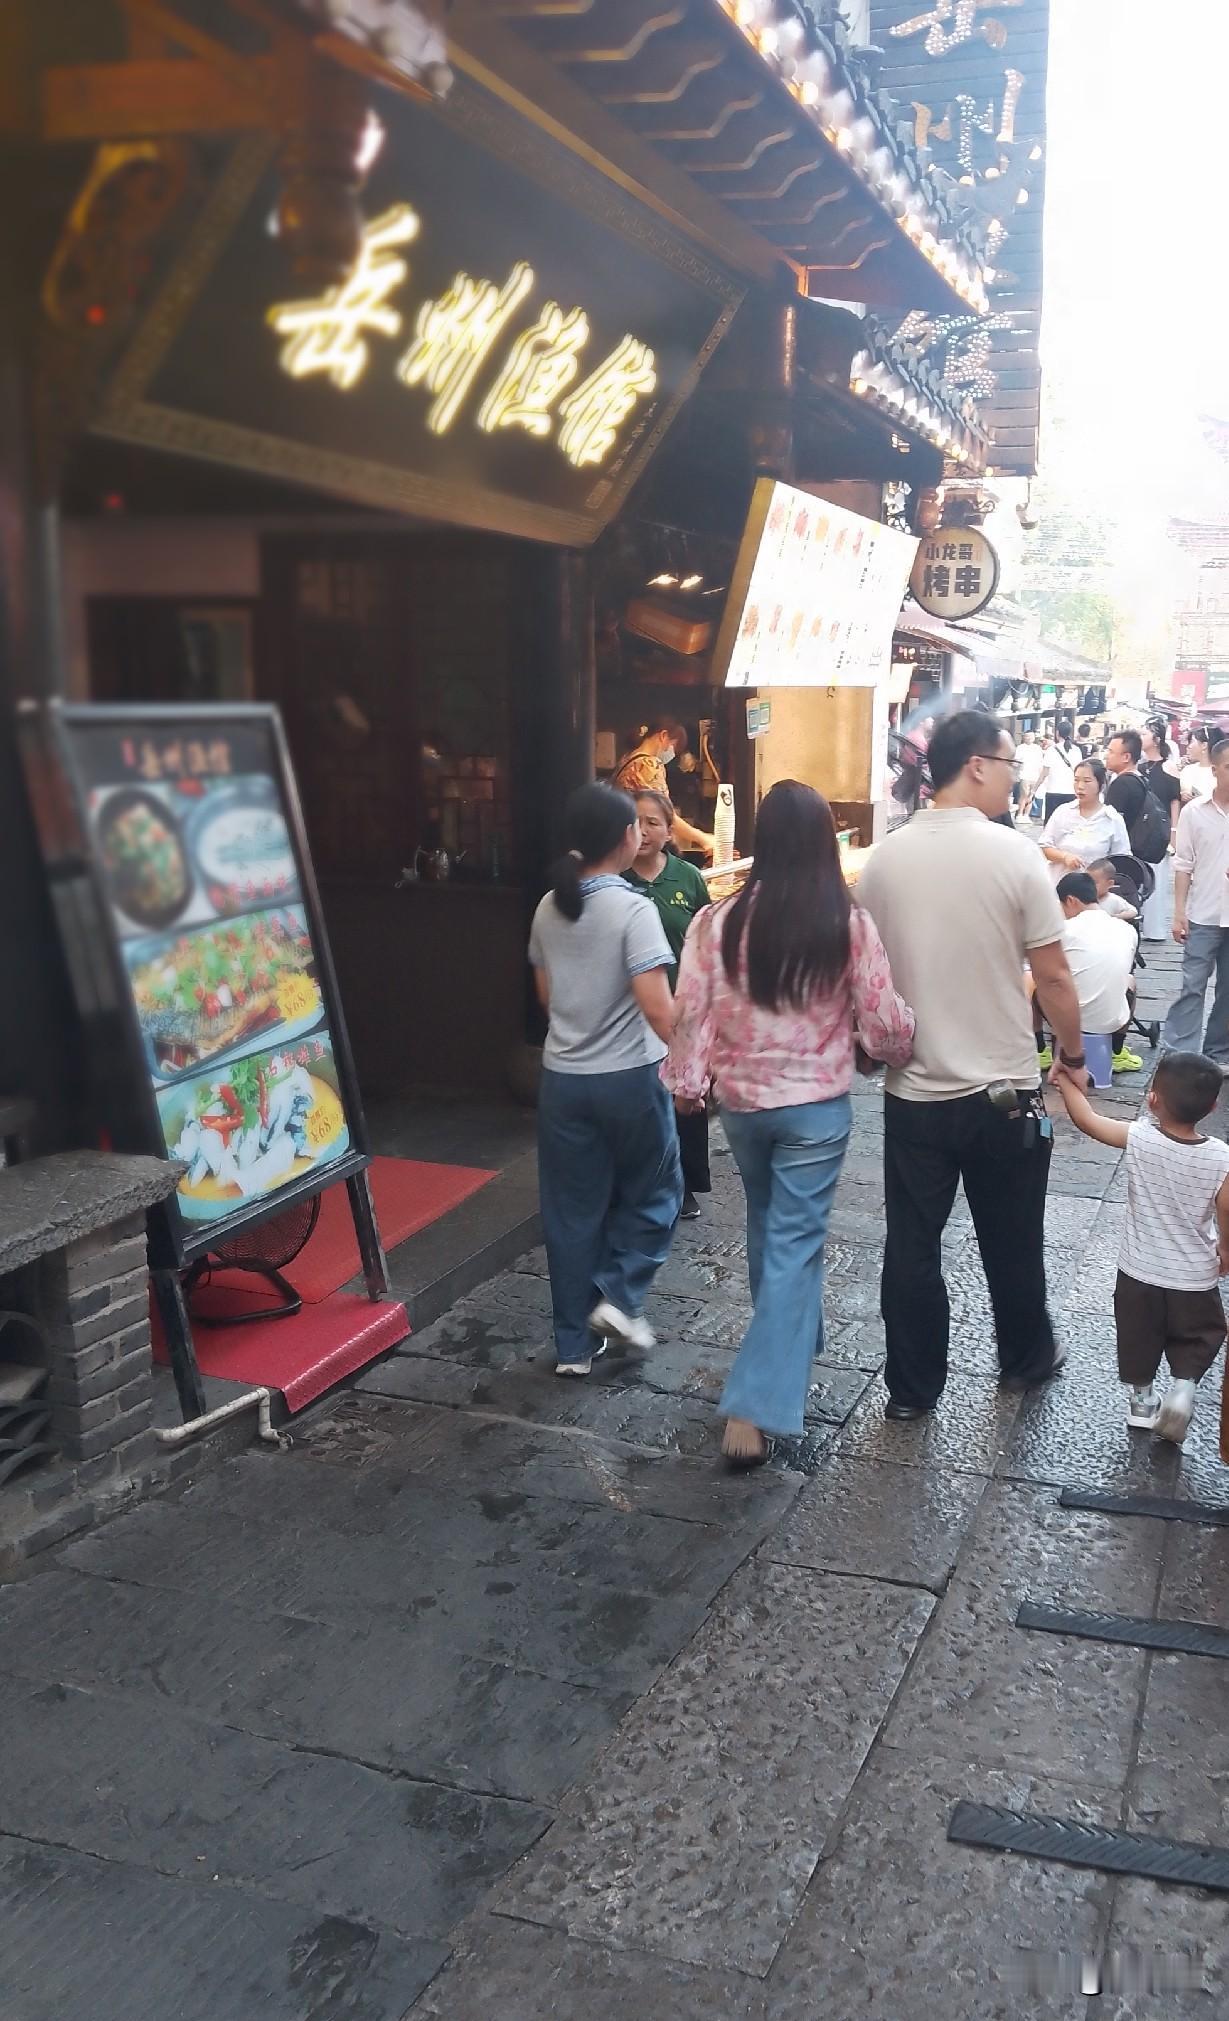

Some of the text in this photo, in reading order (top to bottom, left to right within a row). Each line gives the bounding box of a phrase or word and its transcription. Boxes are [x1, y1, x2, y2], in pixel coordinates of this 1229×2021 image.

[925, 543, 974, 561] 小龙哥
[923, 564, 981, 598] 烤串
